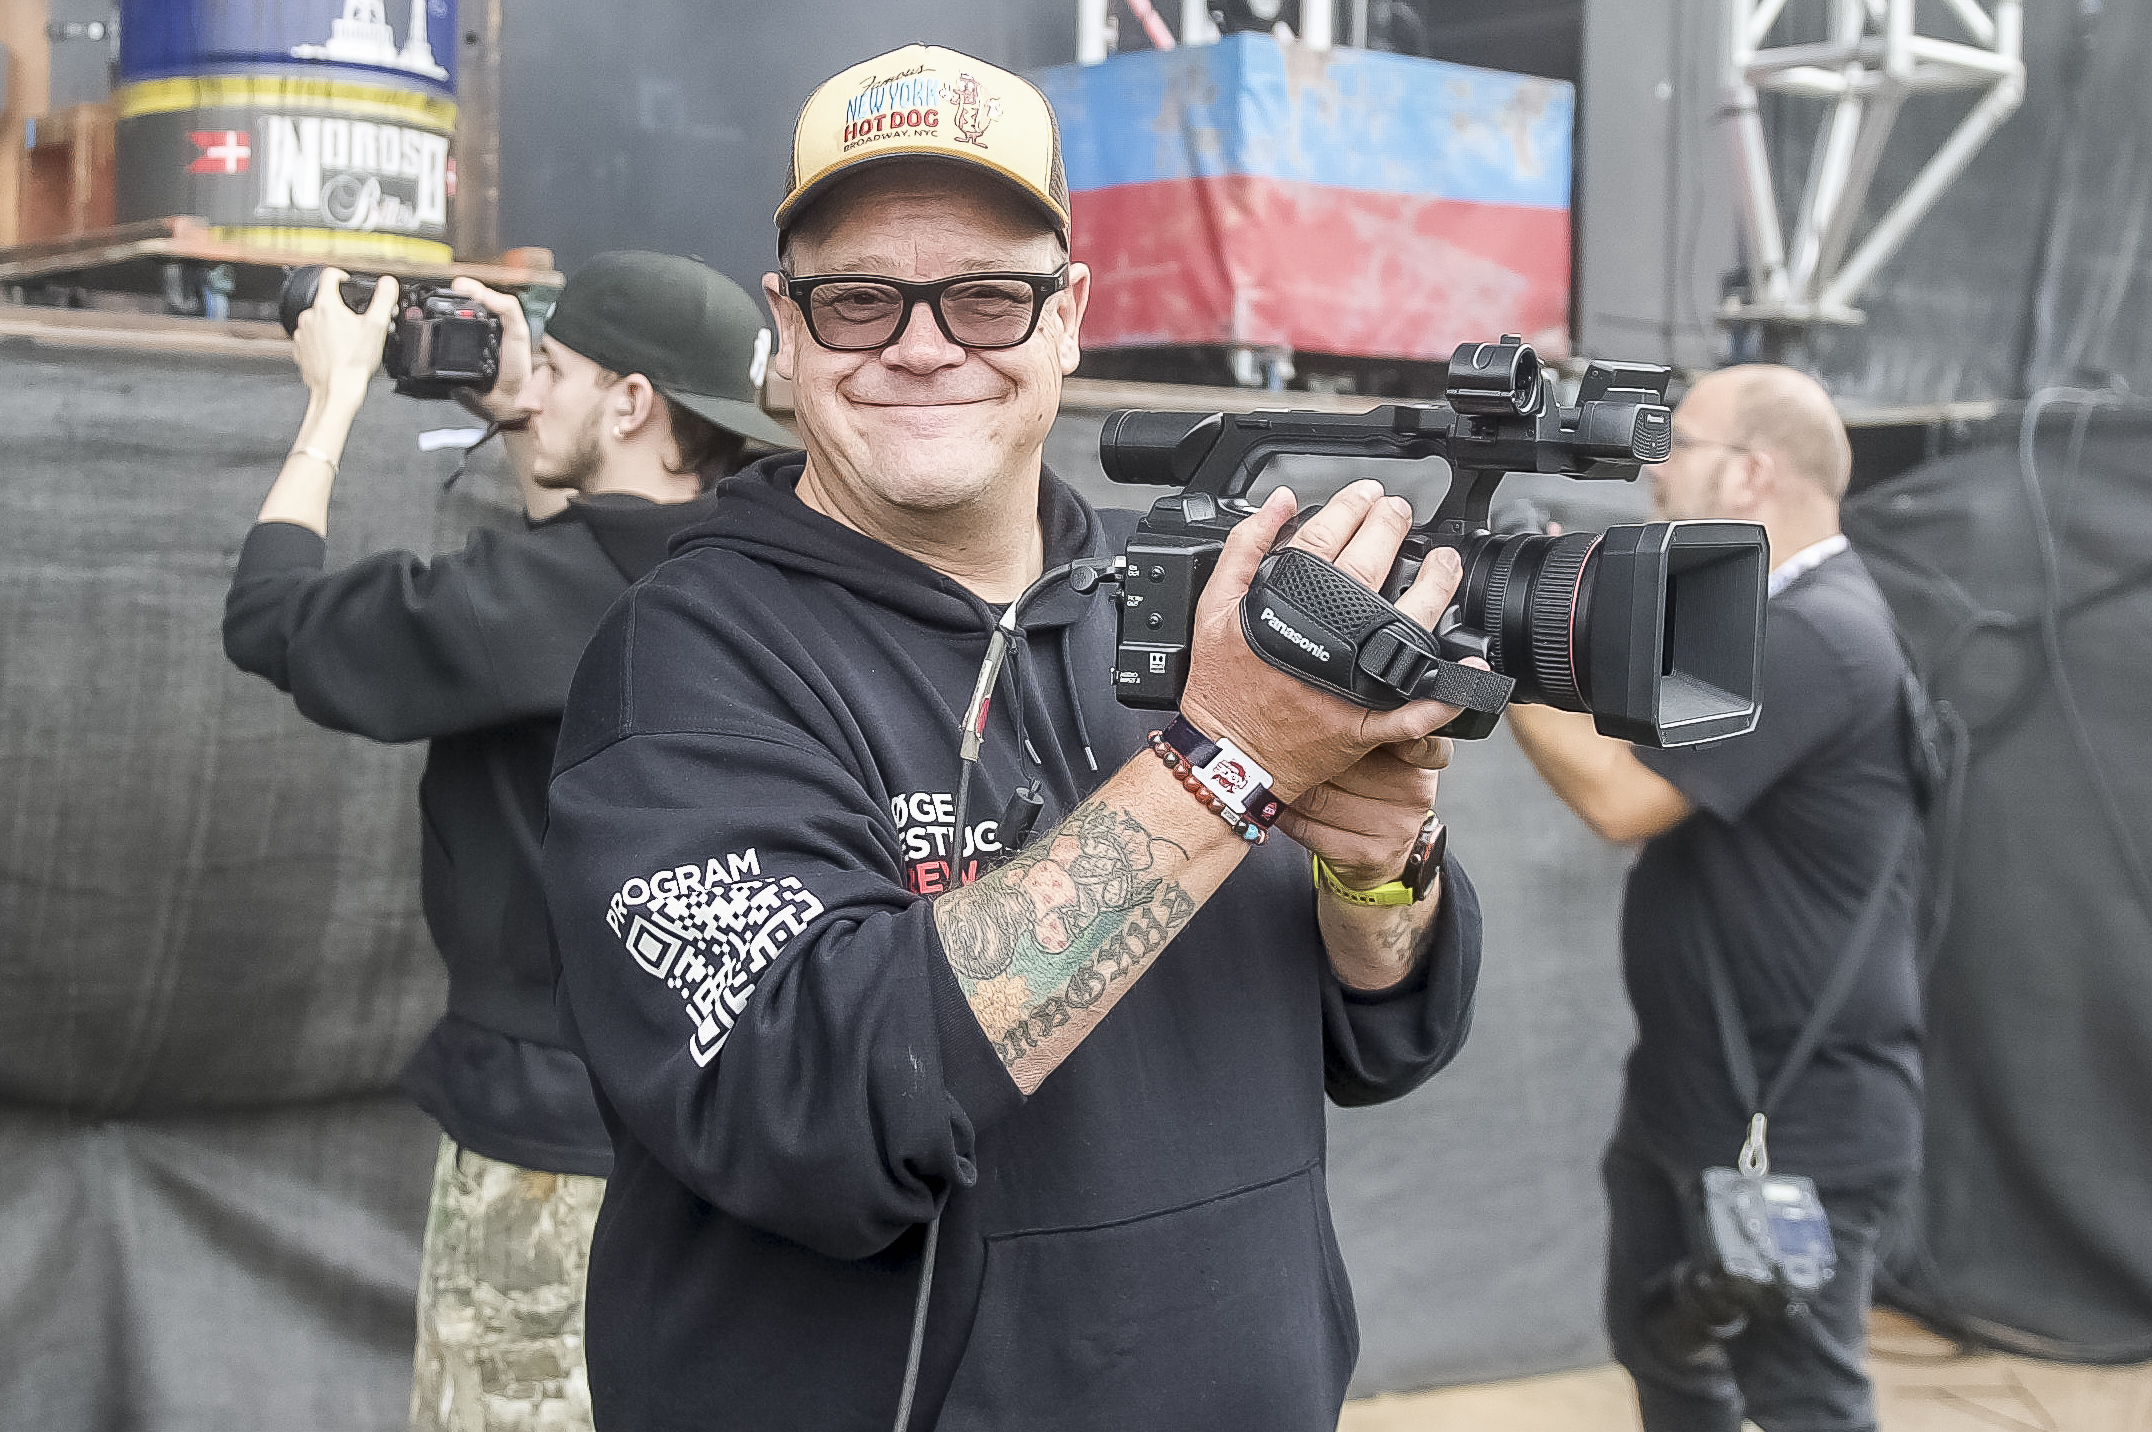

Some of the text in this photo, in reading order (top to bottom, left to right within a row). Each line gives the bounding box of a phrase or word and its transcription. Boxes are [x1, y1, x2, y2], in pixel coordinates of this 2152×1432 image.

[846, 77, 939, 125] NEW YORK
[844, 109, 939, 143] HOT DOG
[914, 129, 938, 138] NYC
[1261, 607, 1330, 661] Panasonic
[891, 792, 956, 828] ØGE
[606, 848, 761, 938] PROGRAM
